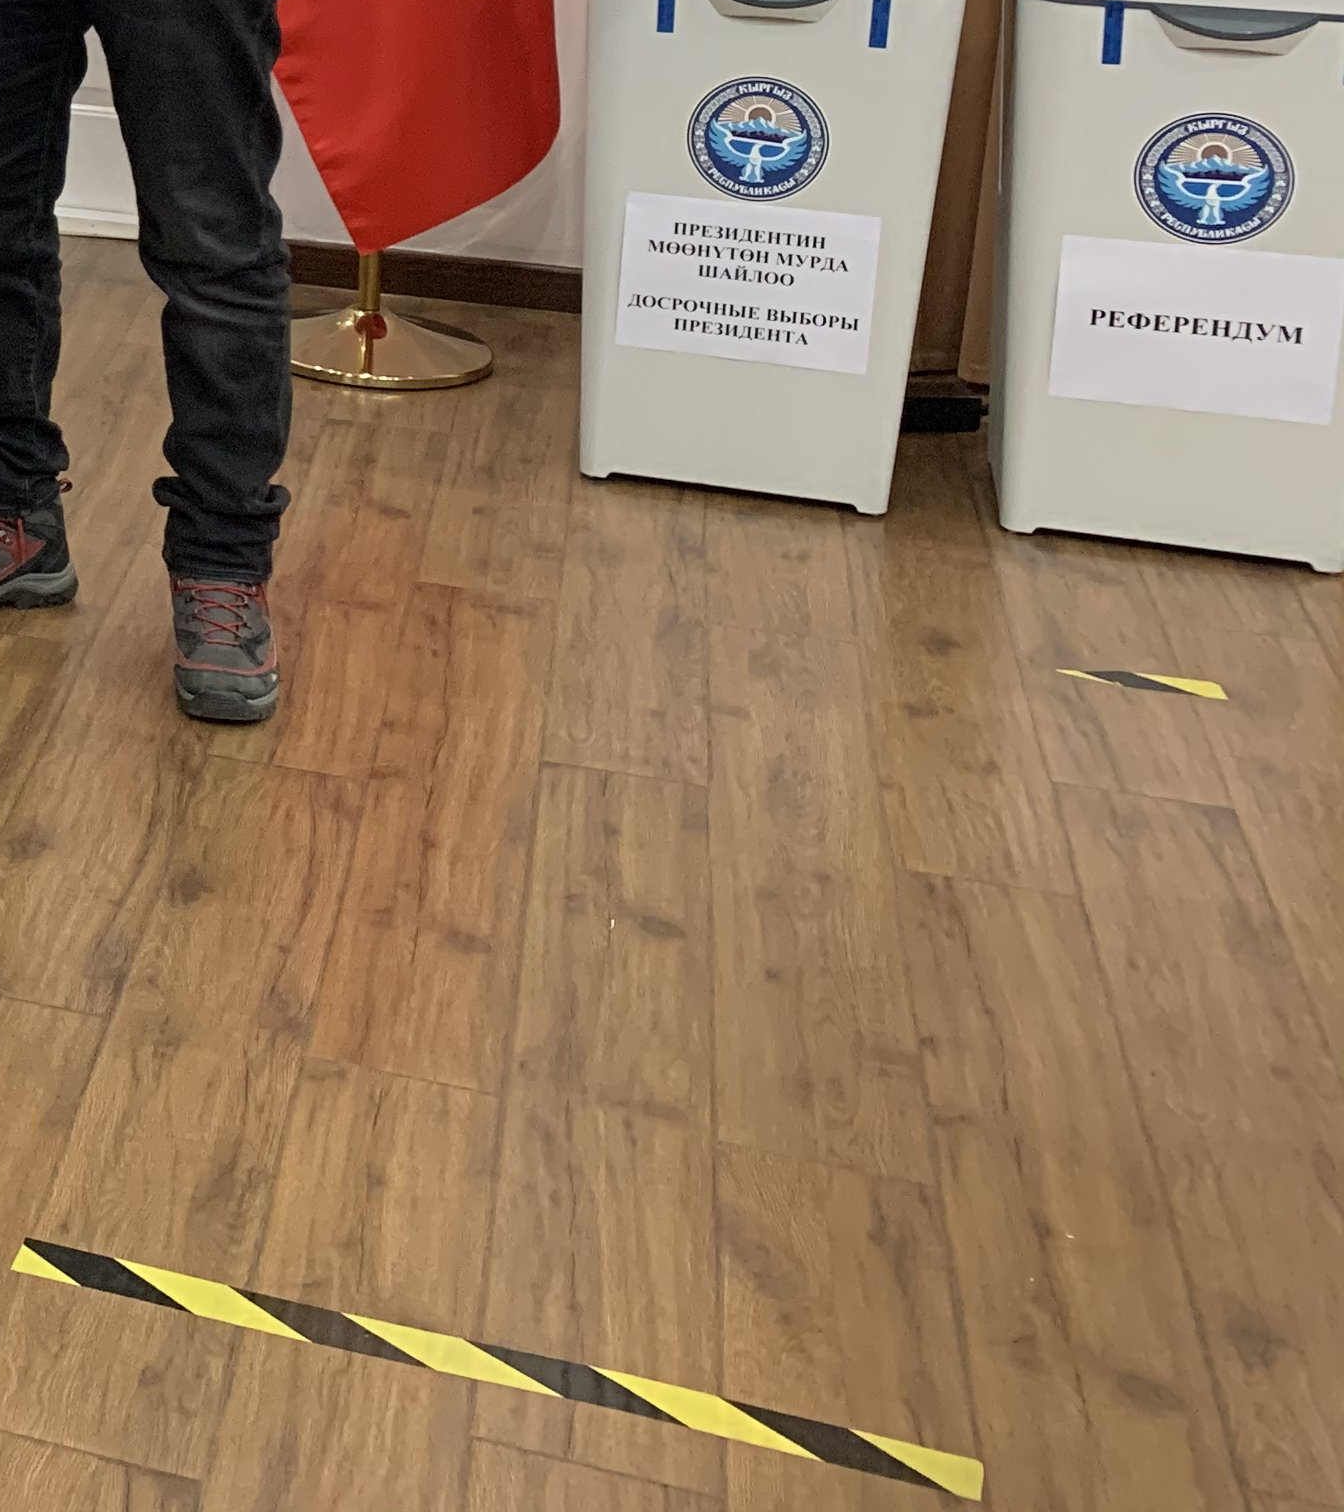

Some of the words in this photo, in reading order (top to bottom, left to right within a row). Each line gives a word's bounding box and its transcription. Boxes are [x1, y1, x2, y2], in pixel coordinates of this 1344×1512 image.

[737, 82, 792, 101] КЫРГЫЗ
[1187, 120, 1249, 136] КЫРГЫЗ
[708, 167, 797, 196] РЕСПУБЛИКАСЫ
[673, 222, 826, 250] ПРЕЗИДЕНТИН
[1160, 212, 1261, 238] РЕСПУБЛИКАСЫ
[647, 239, 770, 265] МӨӨНҮТӨН
[776, 252, 849, 273] МУРДА
[698, 263, 795, 287] ШАЙЛОО
[627, 293, 761, 321] ДОСРОЧНЫЕ
[767, 308, 859, 332] ВЫБОРЫ
[1089, 308, 1304, 345] РЕФЕРЕНДУМ
[674, 318, 808, 347] ПРЕЗИДЕНТА
